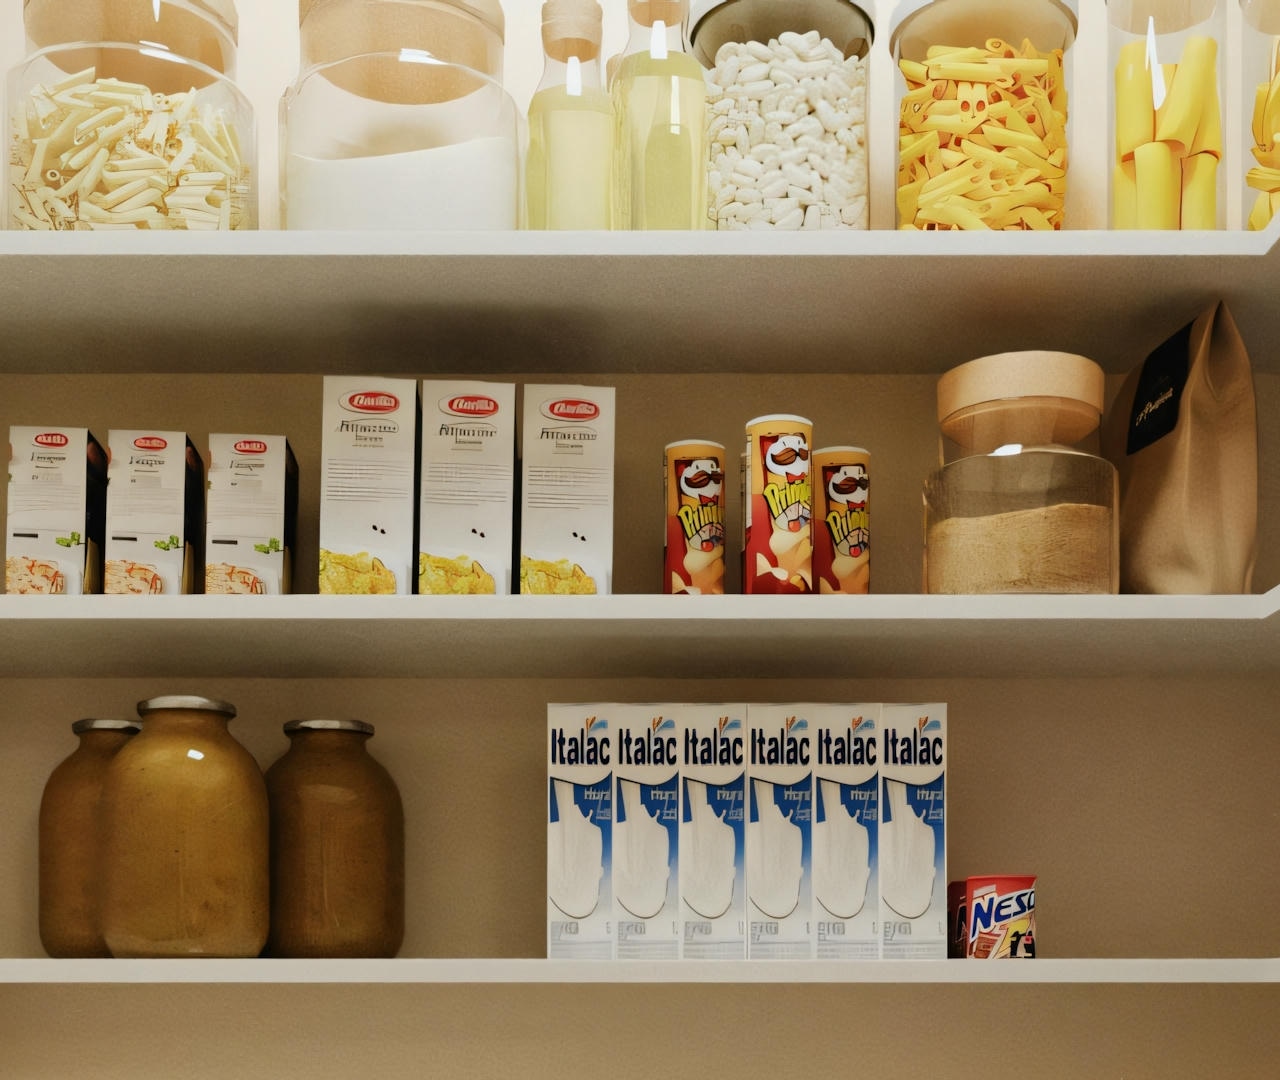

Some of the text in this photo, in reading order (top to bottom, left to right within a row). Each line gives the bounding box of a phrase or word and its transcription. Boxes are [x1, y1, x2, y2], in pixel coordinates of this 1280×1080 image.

[551, 728, 610, 765] Italac
[619, 728, 677, 765] Italac
[685, 728, 743, 765] Italac
[751, 728, 810, 765] Italac
[818, 728, 877, 765] Italac
[884, 728, 943, 765] Italac
